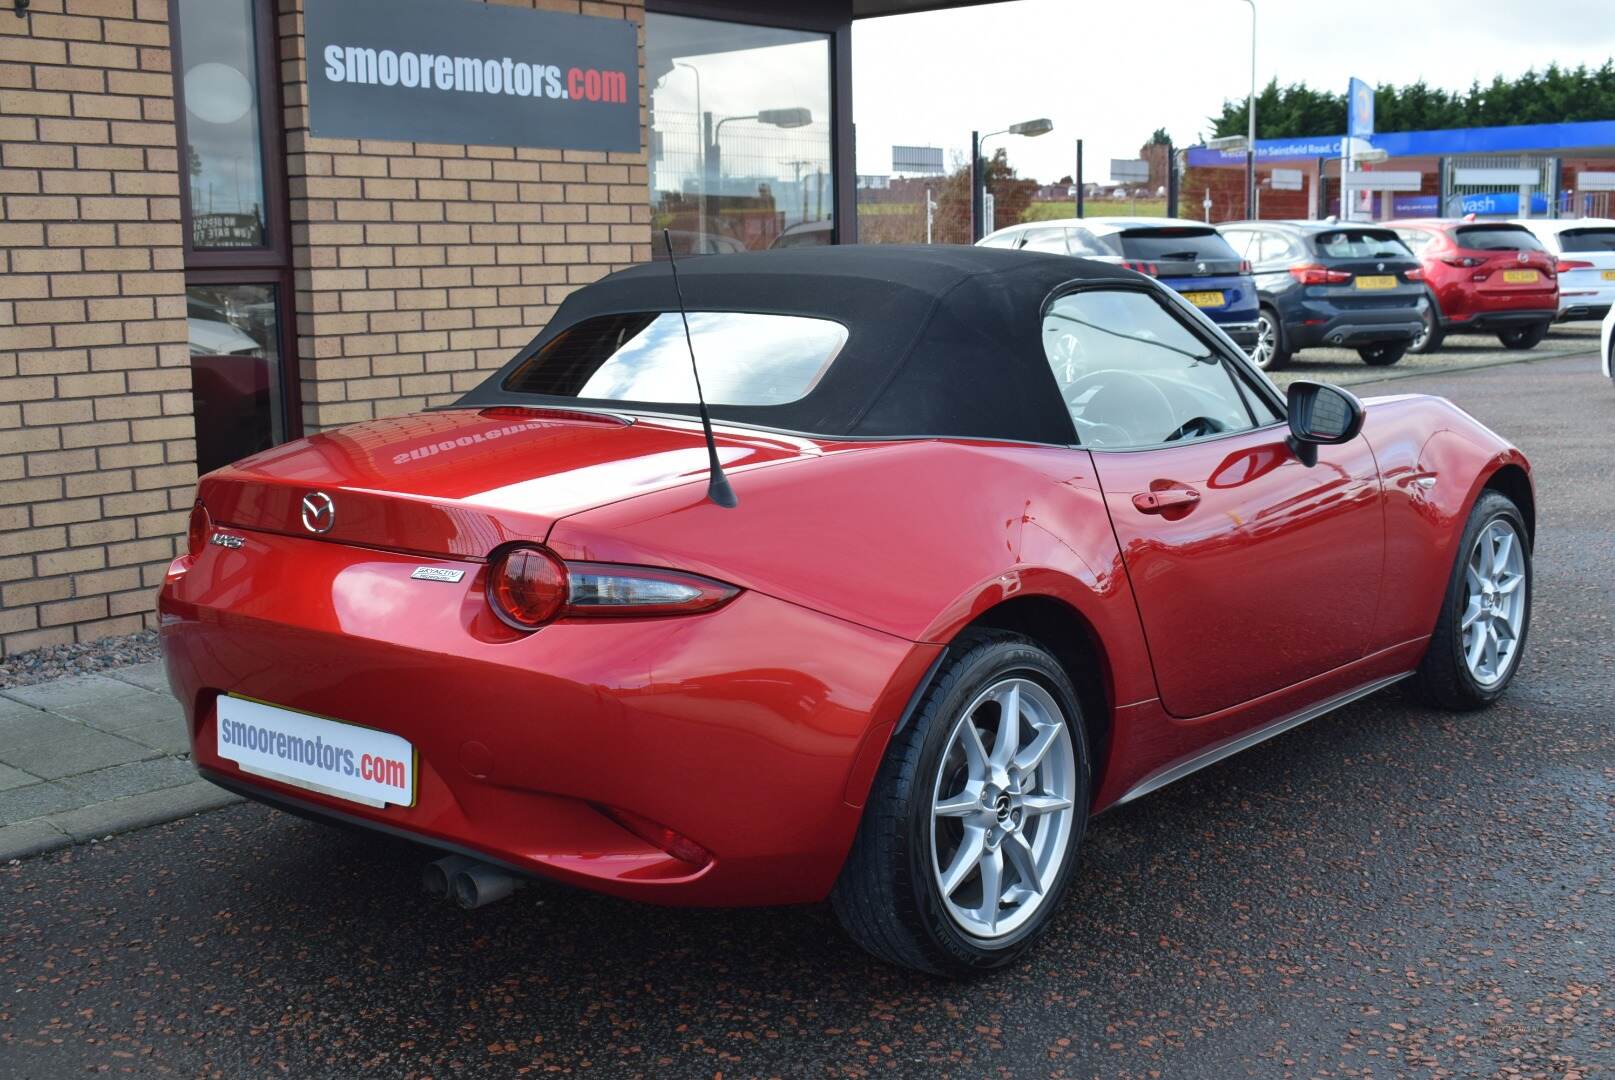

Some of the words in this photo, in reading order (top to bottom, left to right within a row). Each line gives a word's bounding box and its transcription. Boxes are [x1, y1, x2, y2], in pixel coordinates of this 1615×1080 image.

[324, 43, 628, 104] smooremotors.com
[1269, 145, 1307, 156] Saintfield
[222, 717, 406, 789] smooremotors.com
